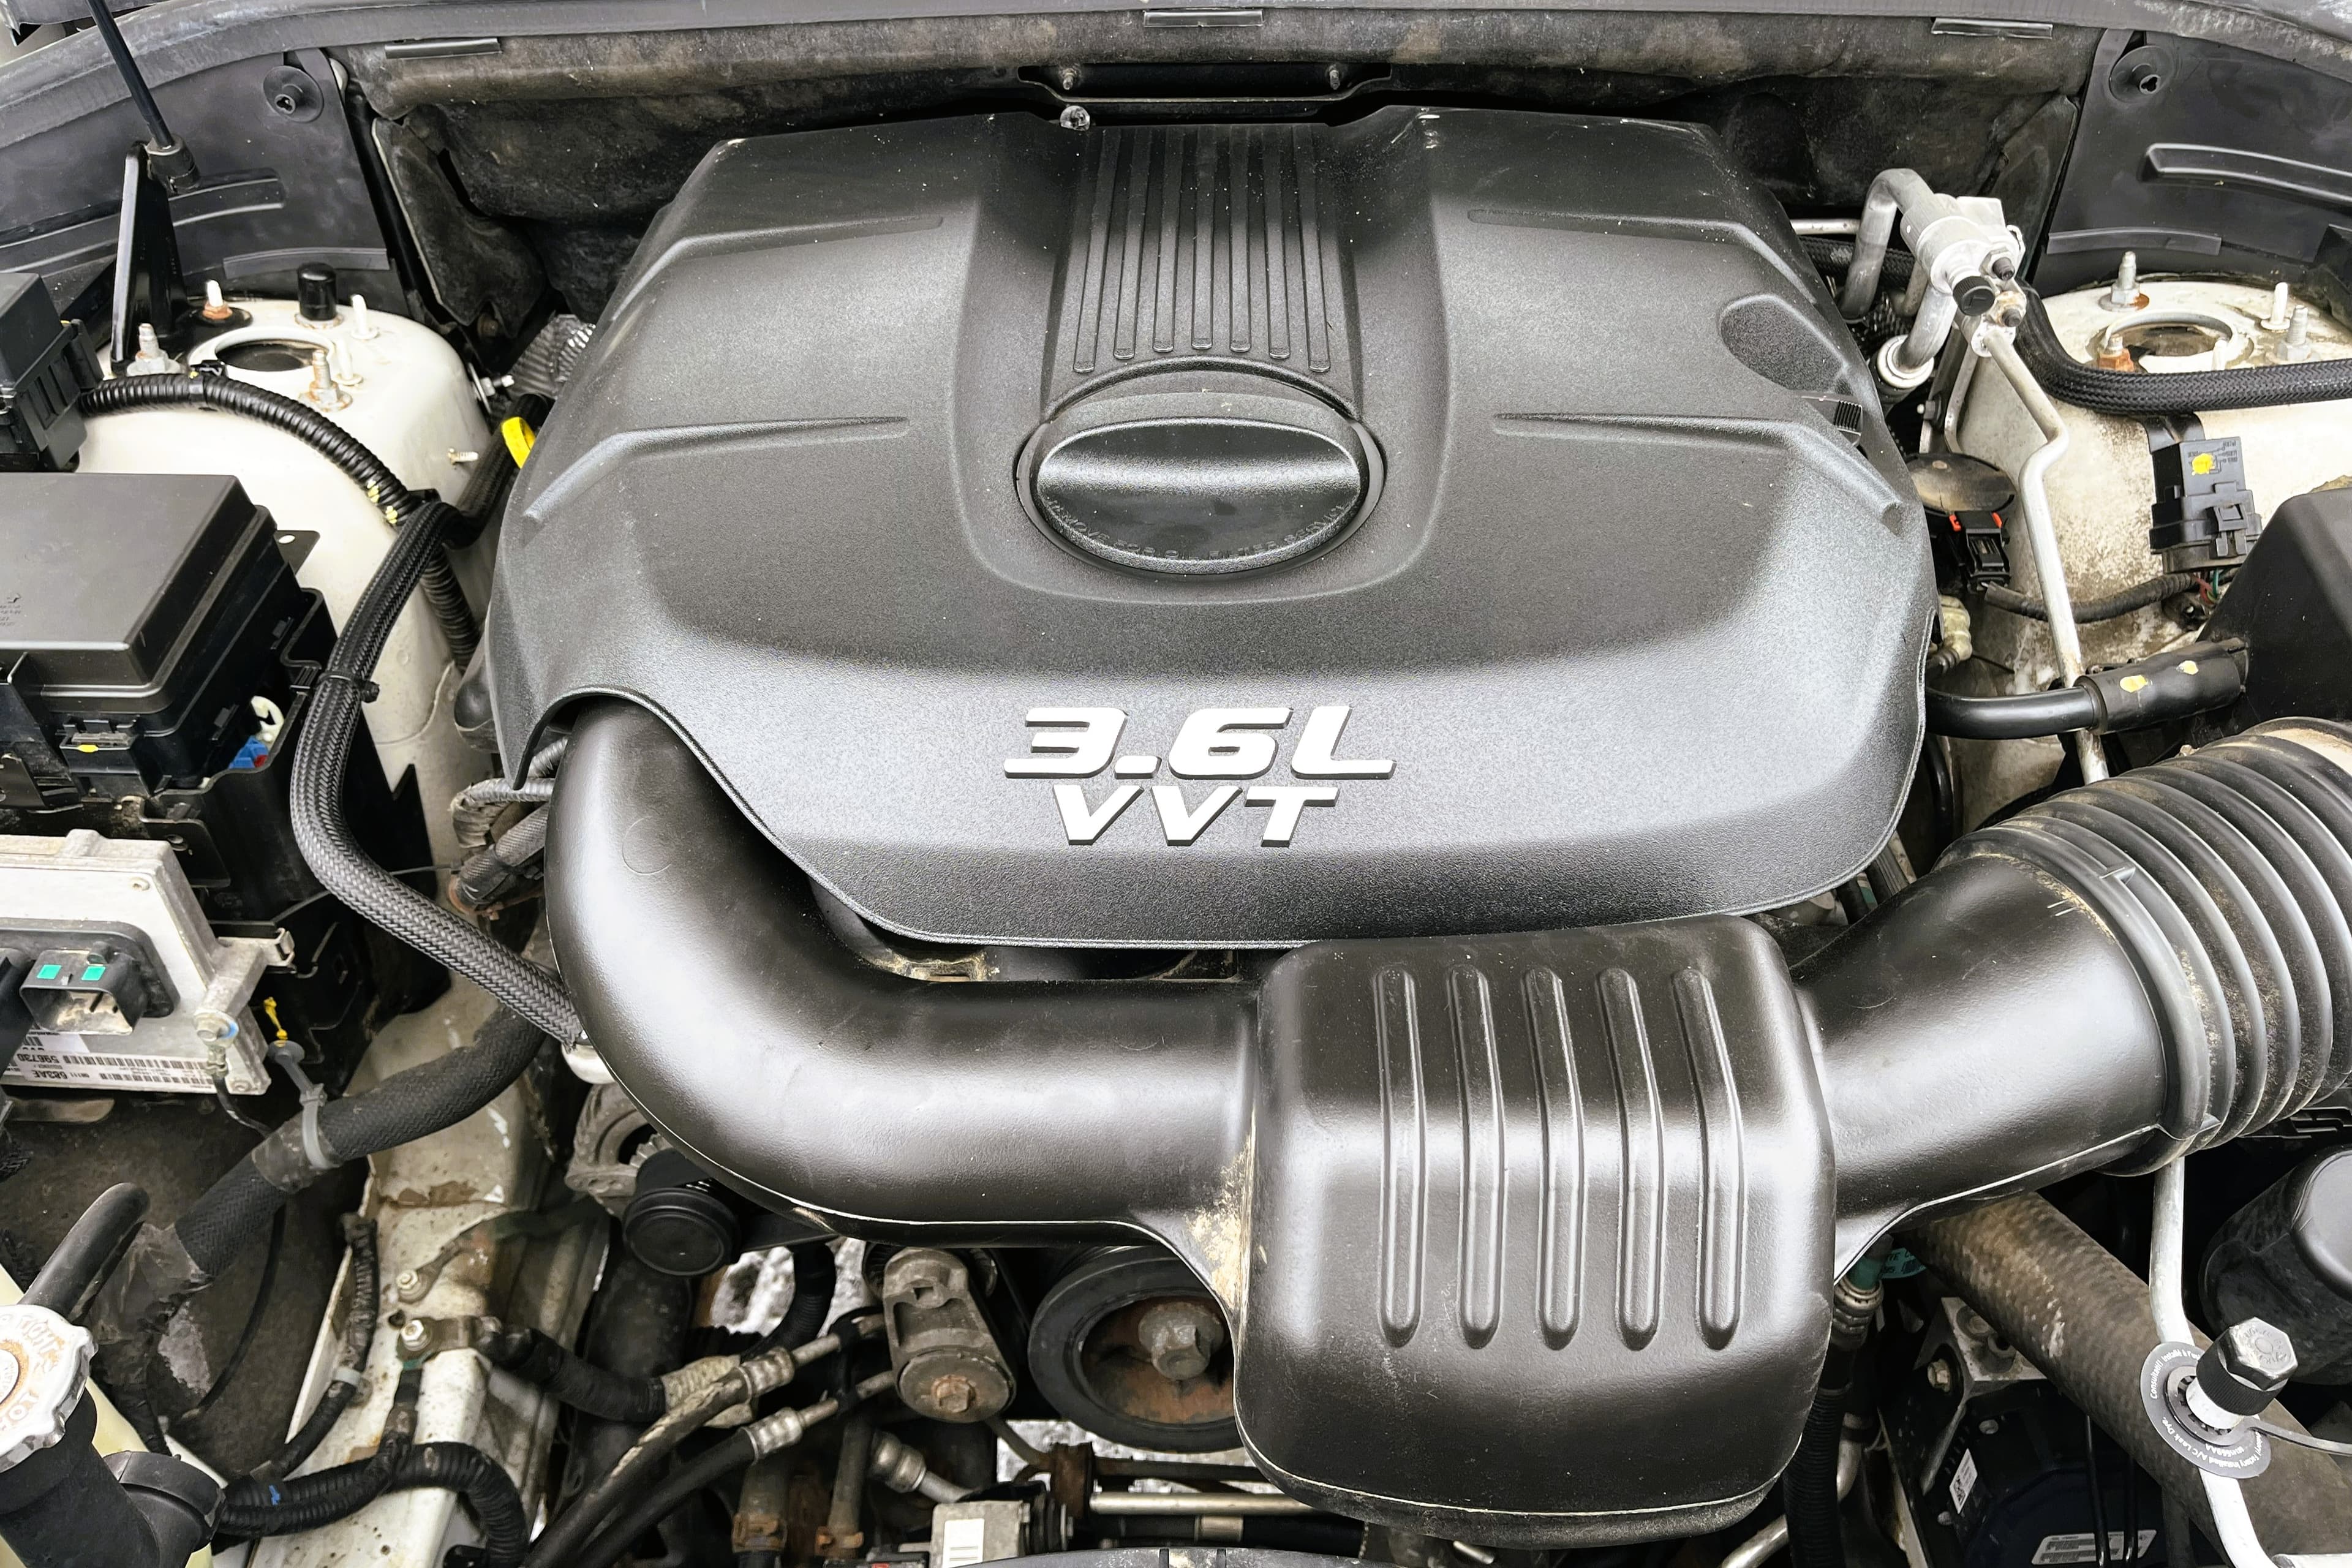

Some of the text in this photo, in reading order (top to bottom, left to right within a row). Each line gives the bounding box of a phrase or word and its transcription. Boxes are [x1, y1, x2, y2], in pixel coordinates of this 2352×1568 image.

[1004, 706, 1397, 780] 3.6L
[1053, 785, 1341, 848] VVT
[2162, 1417, 2176, 1434] Dye.
[2174, 1434, 2192, 1451] Leak
[2192, 1447, 2209, 1461] A/C
